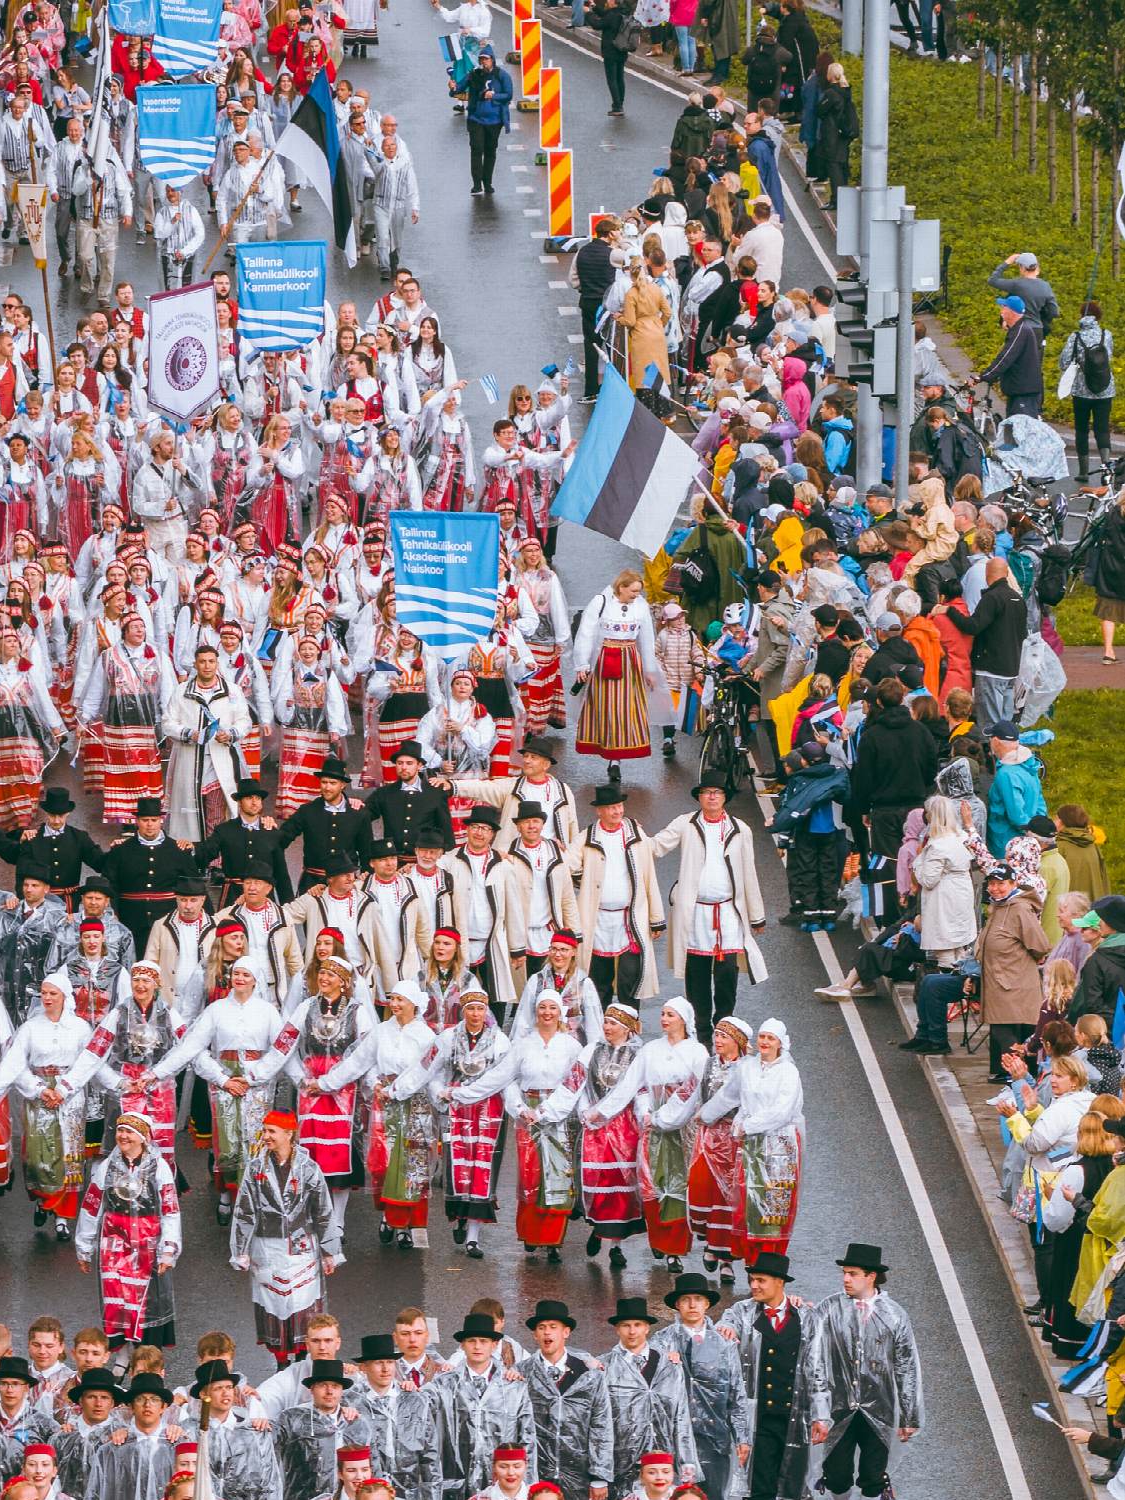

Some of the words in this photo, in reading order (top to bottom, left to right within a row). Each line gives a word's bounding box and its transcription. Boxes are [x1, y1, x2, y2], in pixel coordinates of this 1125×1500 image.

[243, 257, 283, 268] Tallinna
[244, 267, 318, 279] Tehnikaülikooli
[244, 281, 311, 292] Kammerkoor
[400, 527, 436, 538] Tallinna
[401, 539, 472, 552] Tehnikaülikooli
[402, 551, 468, 564] Akadeemiline
[403, 563, 444, 574] Naiskoor
